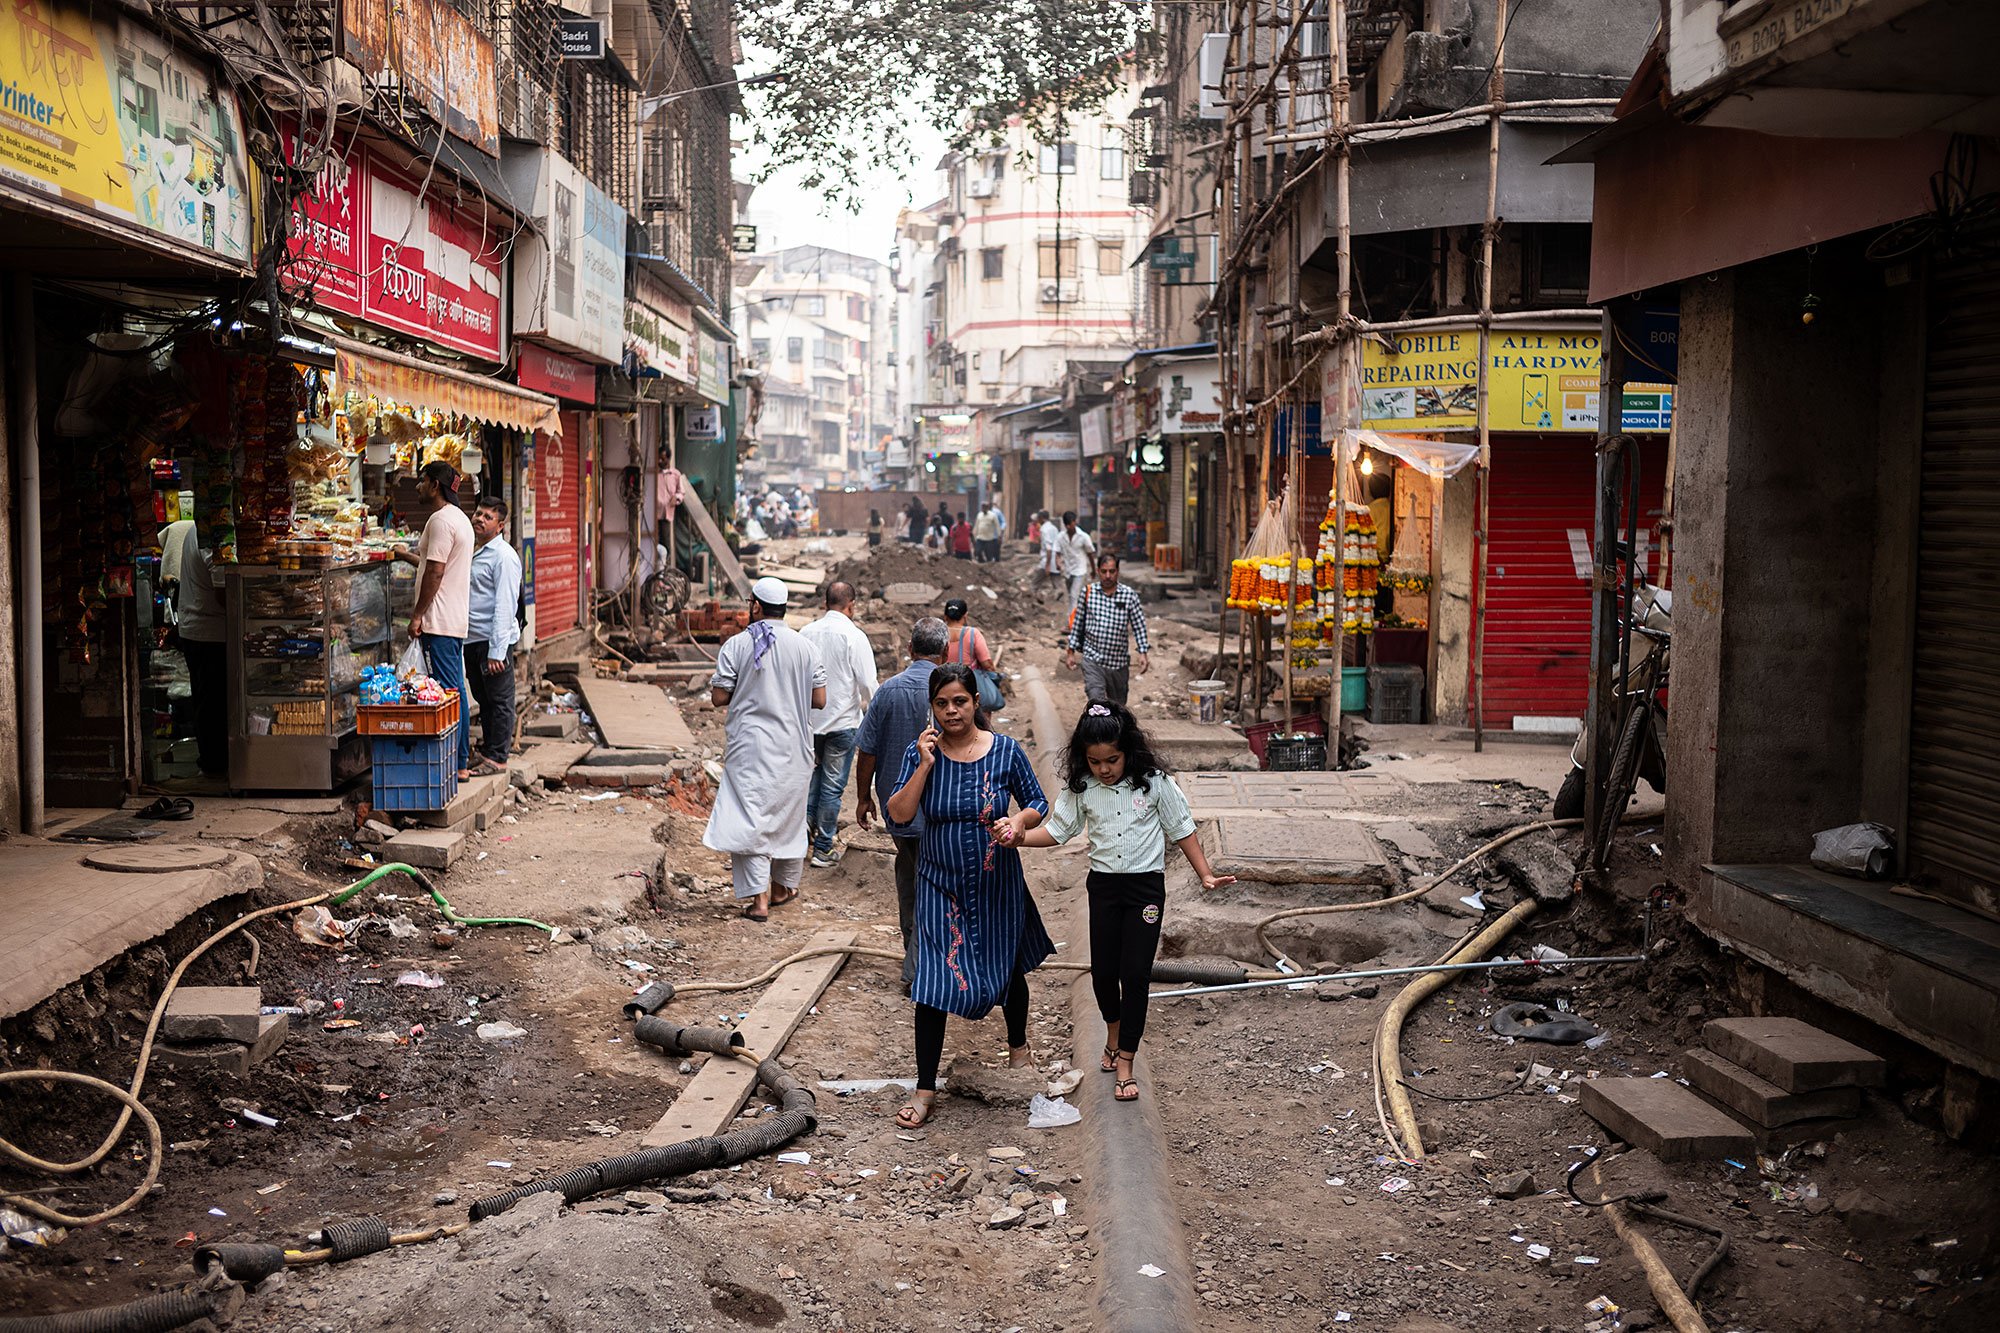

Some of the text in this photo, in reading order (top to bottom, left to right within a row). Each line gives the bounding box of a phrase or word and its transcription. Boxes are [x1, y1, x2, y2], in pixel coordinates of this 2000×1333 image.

[561, 31, 589, 41] Badri
[1752, 17, 1786, 54] BORA
[1381, 335, 1461, 355] OBILE
[1502, 337, 1548, 349] ALL
[1363, 361, 1478, 384] REPAIRING
[1621, 417, 1658, 425] NOKIA
